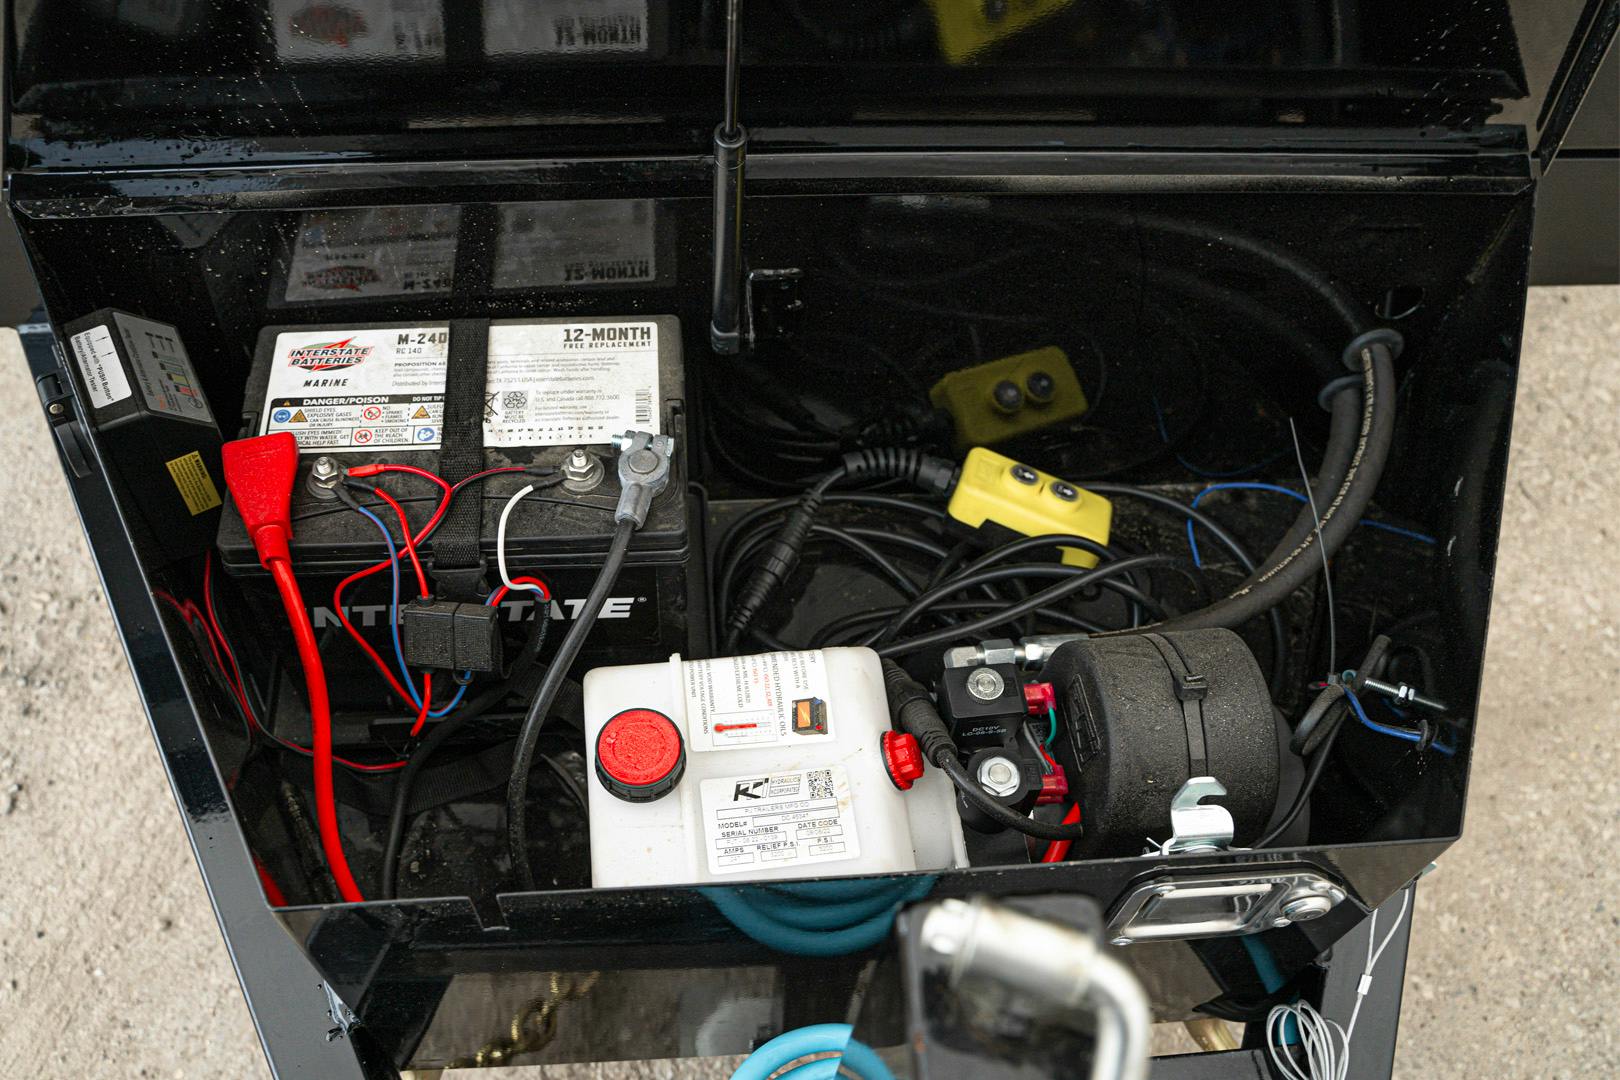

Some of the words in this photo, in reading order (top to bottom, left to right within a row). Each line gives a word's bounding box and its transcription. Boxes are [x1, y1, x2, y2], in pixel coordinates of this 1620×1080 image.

[564, 326, 651, 342] 12-MONTH
[83, 332, 95, 354] Equipped
[290, 347, 369, 357] INTERSTATE
[291, 356, 363, 366] BATTERIES
[303, 378, 349, 388] MARINE
[303, 396, 389, 406] DANGER/POISON
[774, 682, 784, 719] HYDRAULIC
[700, 702, 708, 734] CONDITIONS
[718, 821, 747, 830] MODEL#
[798, 820, 816, 829] DATE
[818, 818, 838, 827] CODE
[748, 826, 778, 835] NUMBER
[757, 842, 781, 850] RELIEF
